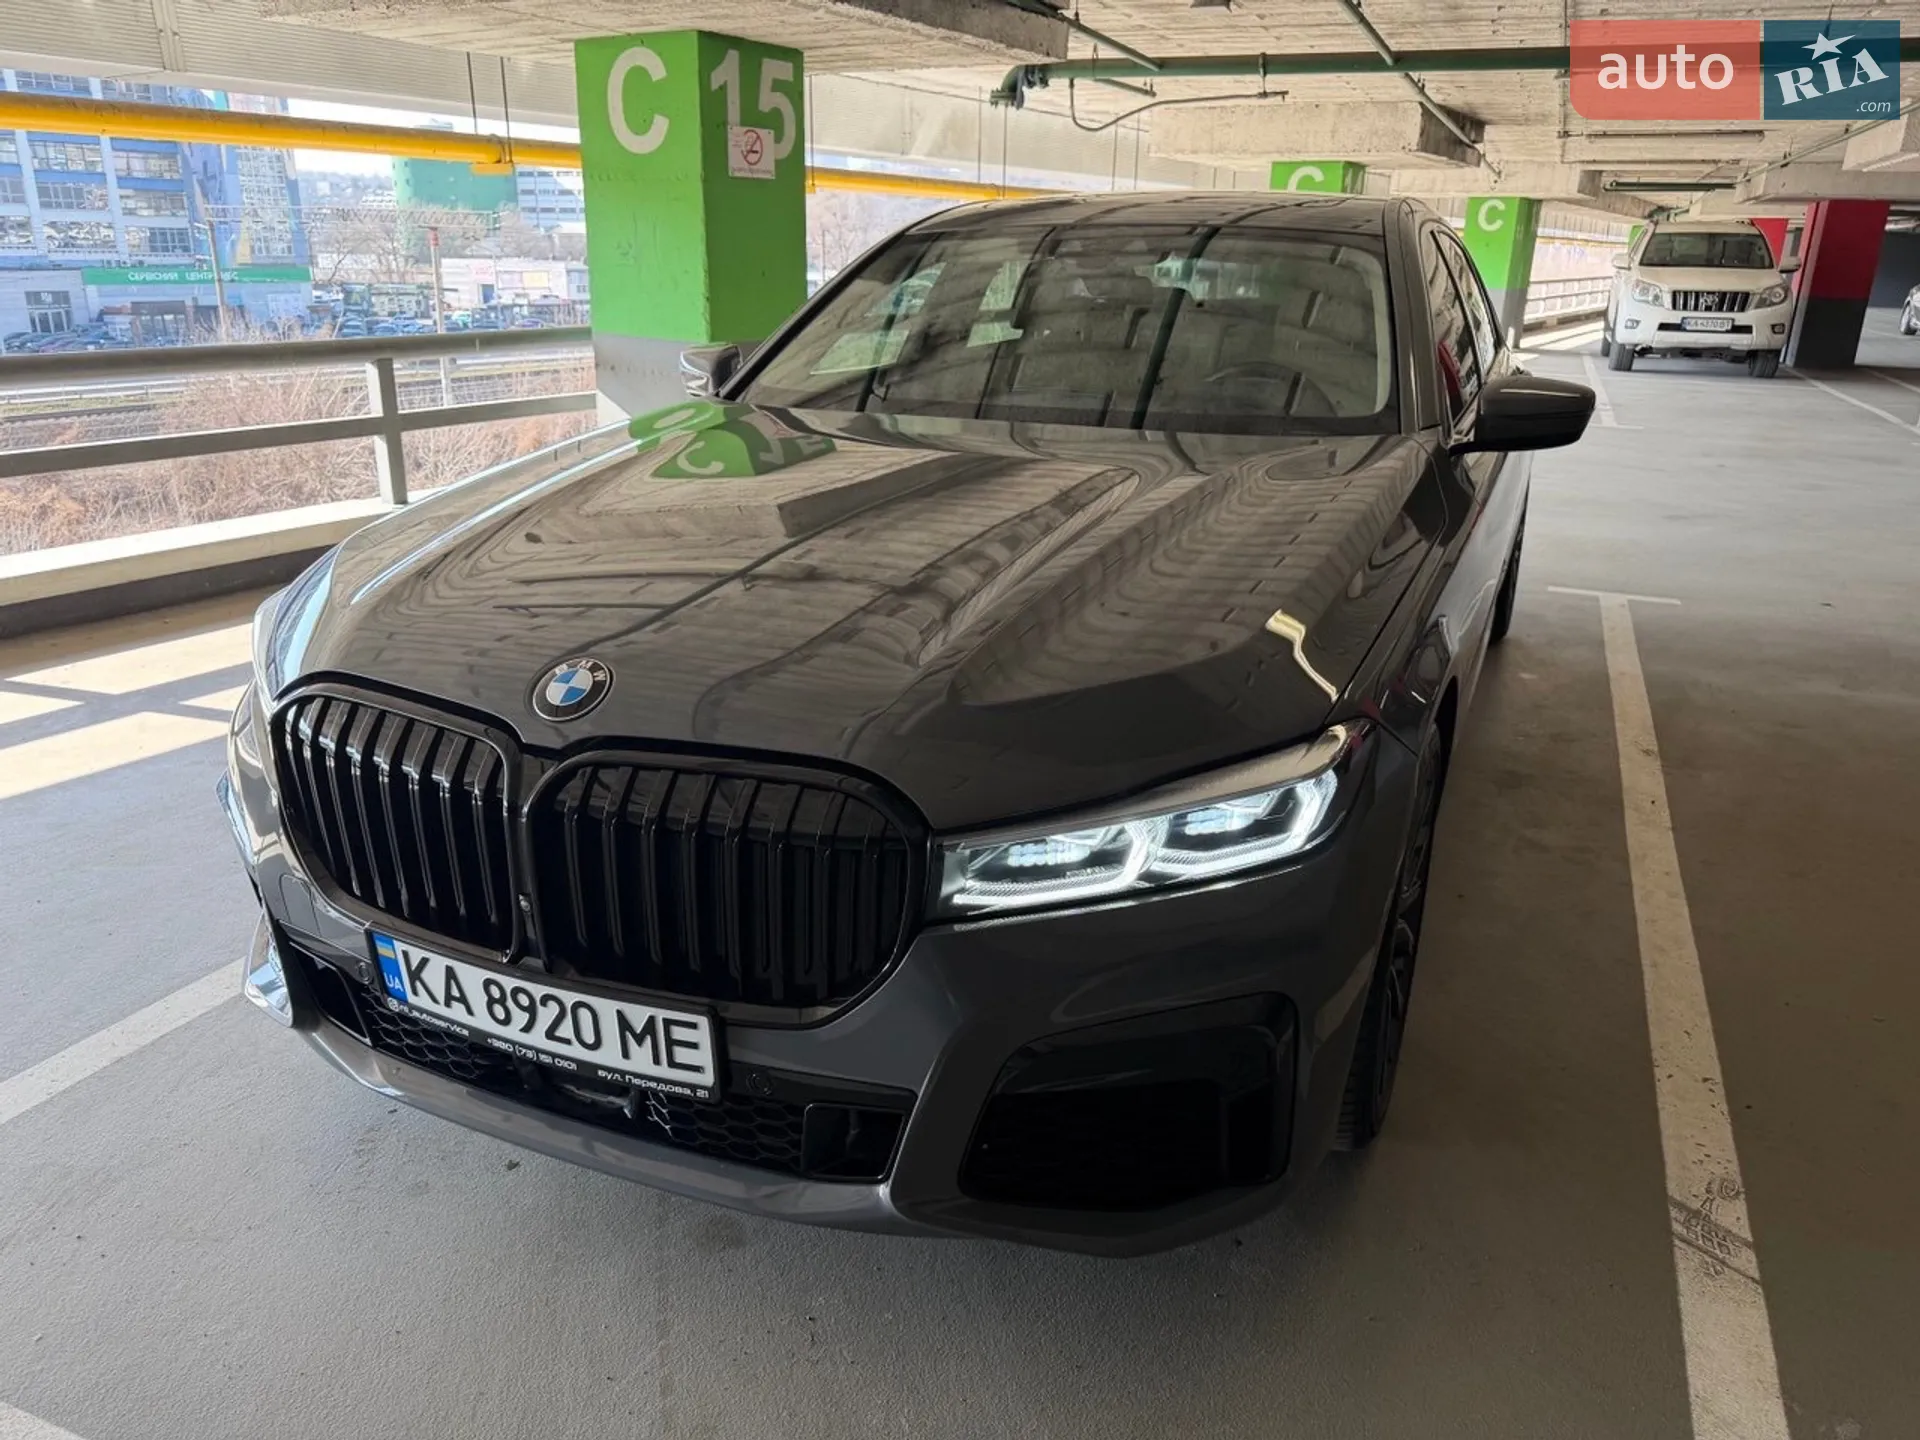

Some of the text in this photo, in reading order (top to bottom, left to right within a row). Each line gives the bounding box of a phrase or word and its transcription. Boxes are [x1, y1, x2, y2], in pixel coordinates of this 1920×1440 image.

[606, 46, 670, 155] C
[710, 49, 797, 160] 15
[1477, 199, 1506, 232] C
[554, 659, 607, 681] BMW
[383, 972, 404, 992] UA
[401, 949, 706, 1074] KA 8920 ME
